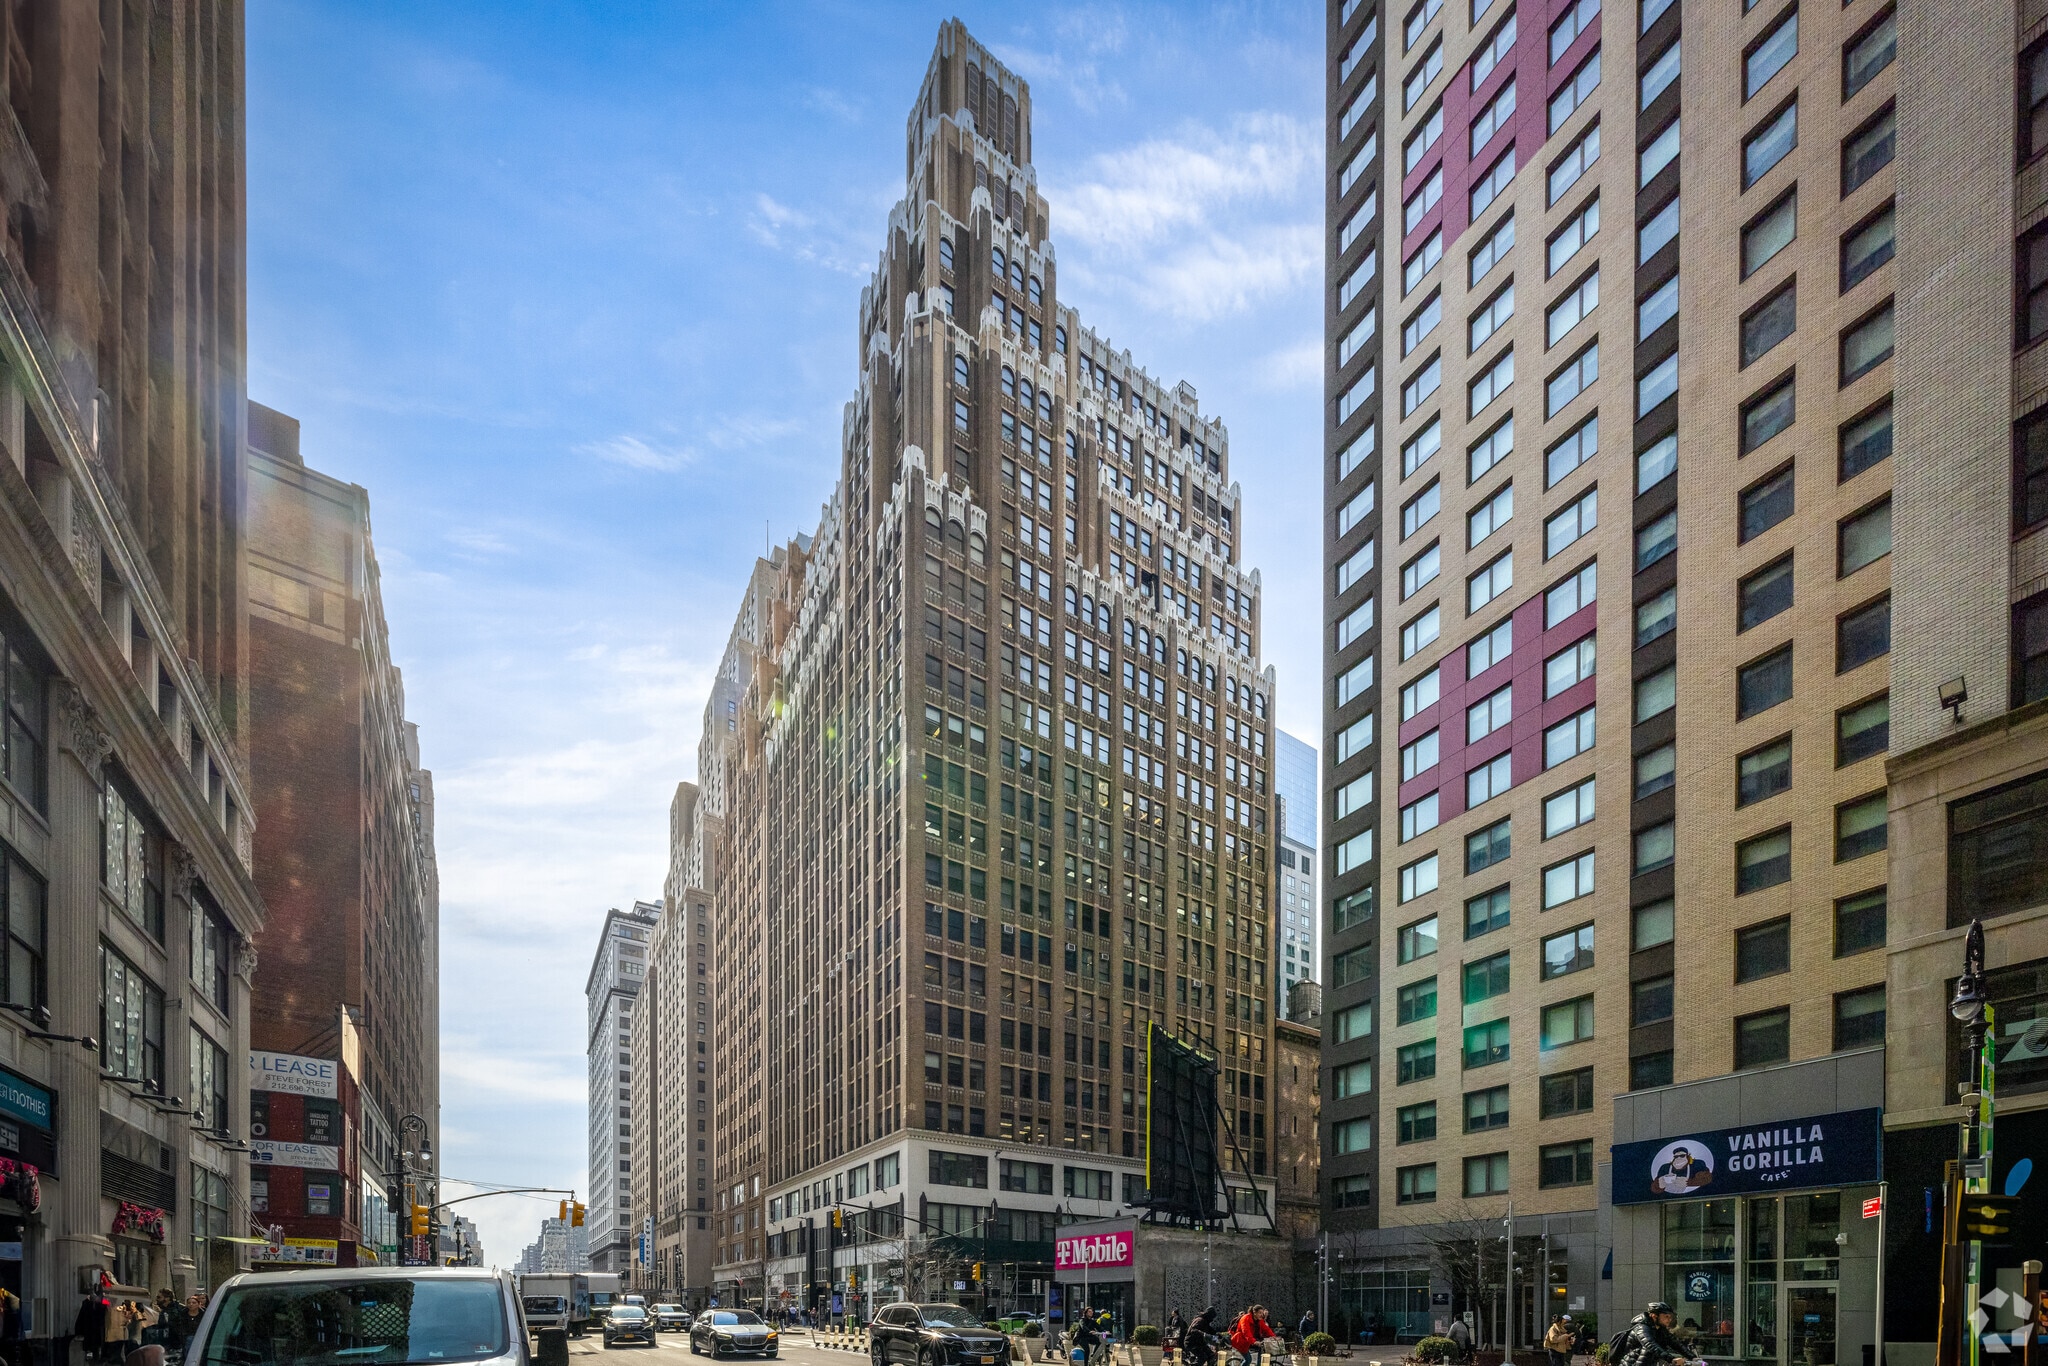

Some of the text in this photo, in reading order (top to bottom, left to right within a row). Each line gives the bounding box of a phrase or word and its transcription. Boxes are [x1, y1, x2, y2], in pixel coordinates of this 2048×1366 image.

[262, 1056, 332, 1079] LEASE
[265, 1074, 332, 1088] STEVE FOREST
[309, 1118, 329, 1128] TATTOO
[1728, 1124, 1824, 1152] VANILLA
[278, 1143, 318, 1155] LEASE
[1728, 1145, 1824, 1172] GORILLA
